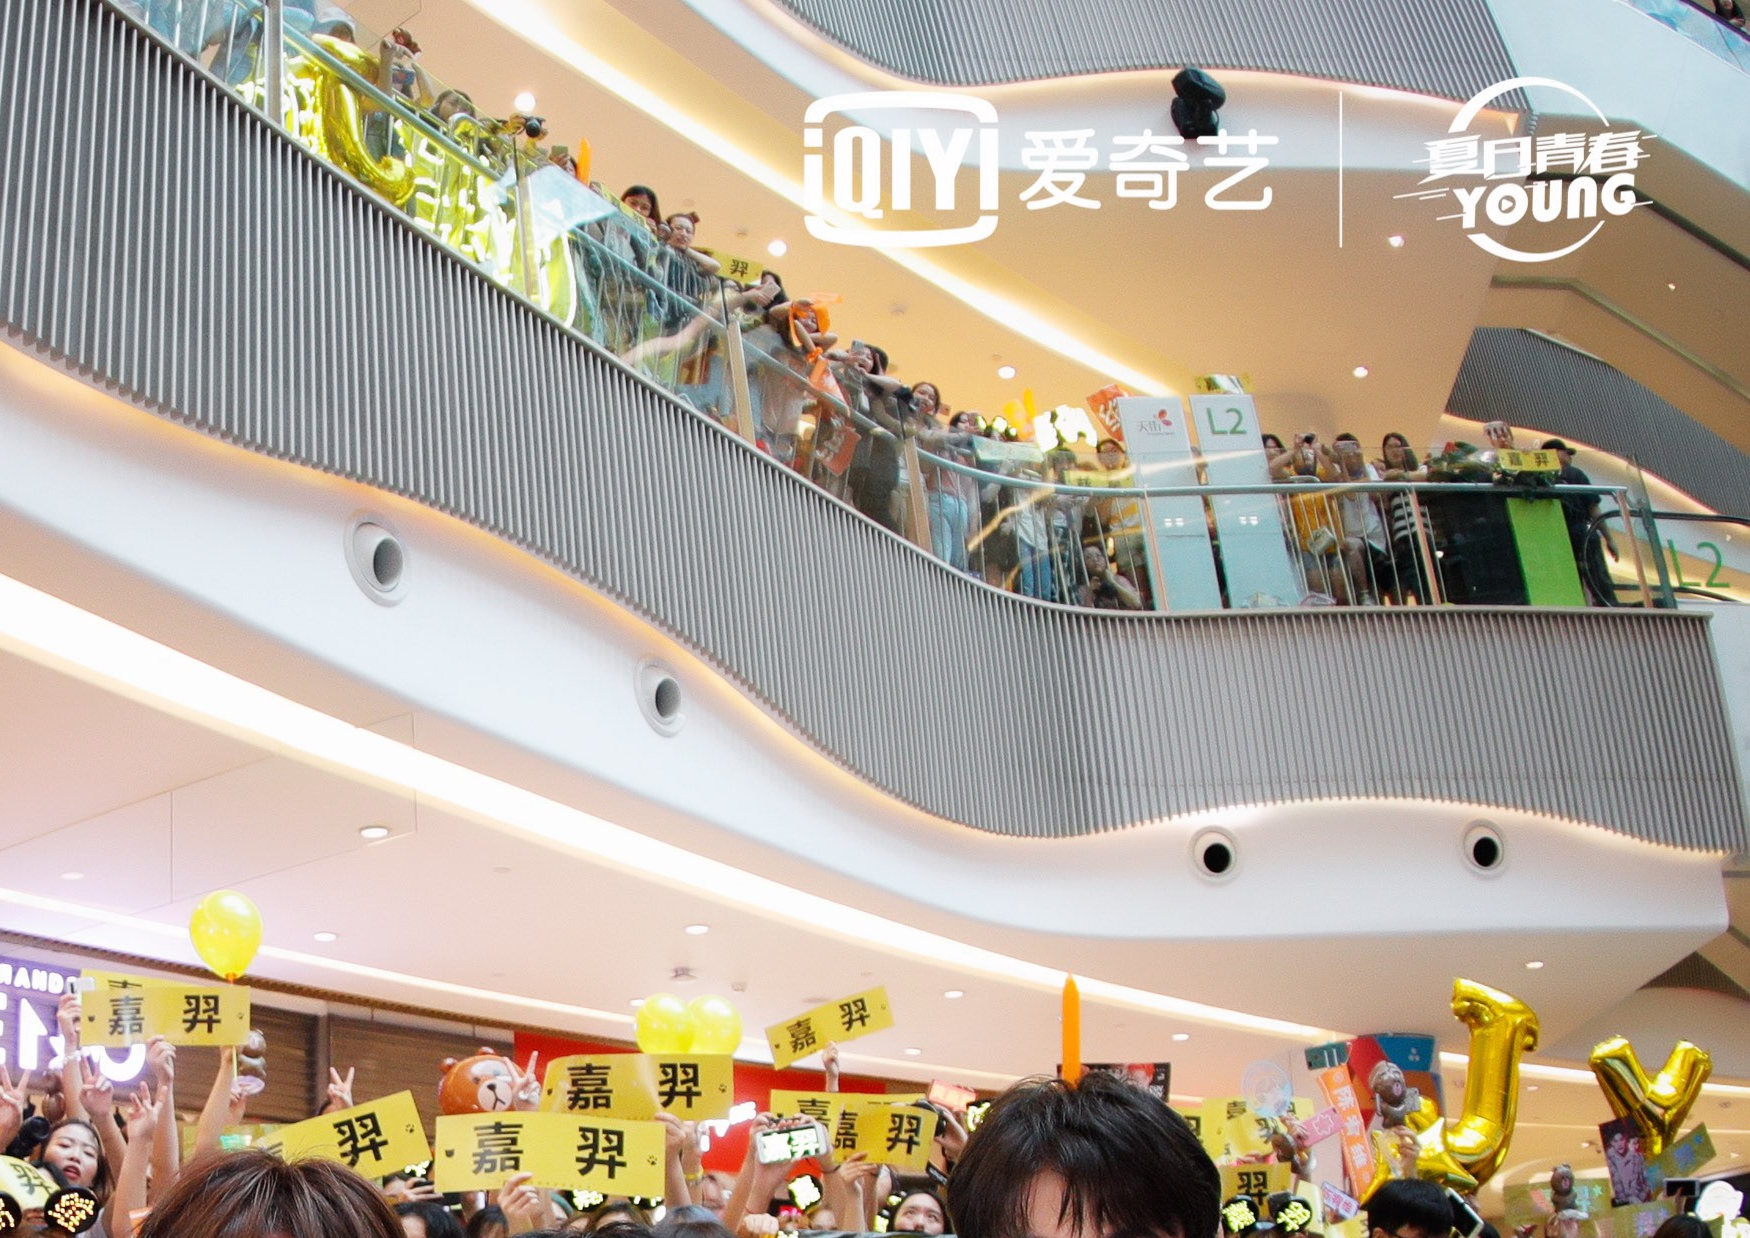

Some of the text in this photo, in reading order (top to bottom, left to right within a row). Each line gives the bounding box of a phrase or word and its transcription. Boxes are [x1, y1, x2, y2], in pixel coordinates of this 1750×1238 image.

[1206, 407, 1247, 435] L2
[1667, 539, 1731, 588] L2
[108, 994, 221, 1036] 嘉羿
[786, 997, 870, 1053] 嘉羿
[567, 1063, 702, 1110] 嘉羿
[472, 1122, 627, 1179] 嘉羿
[835, 1110, 923, 1155] 嘉羿
